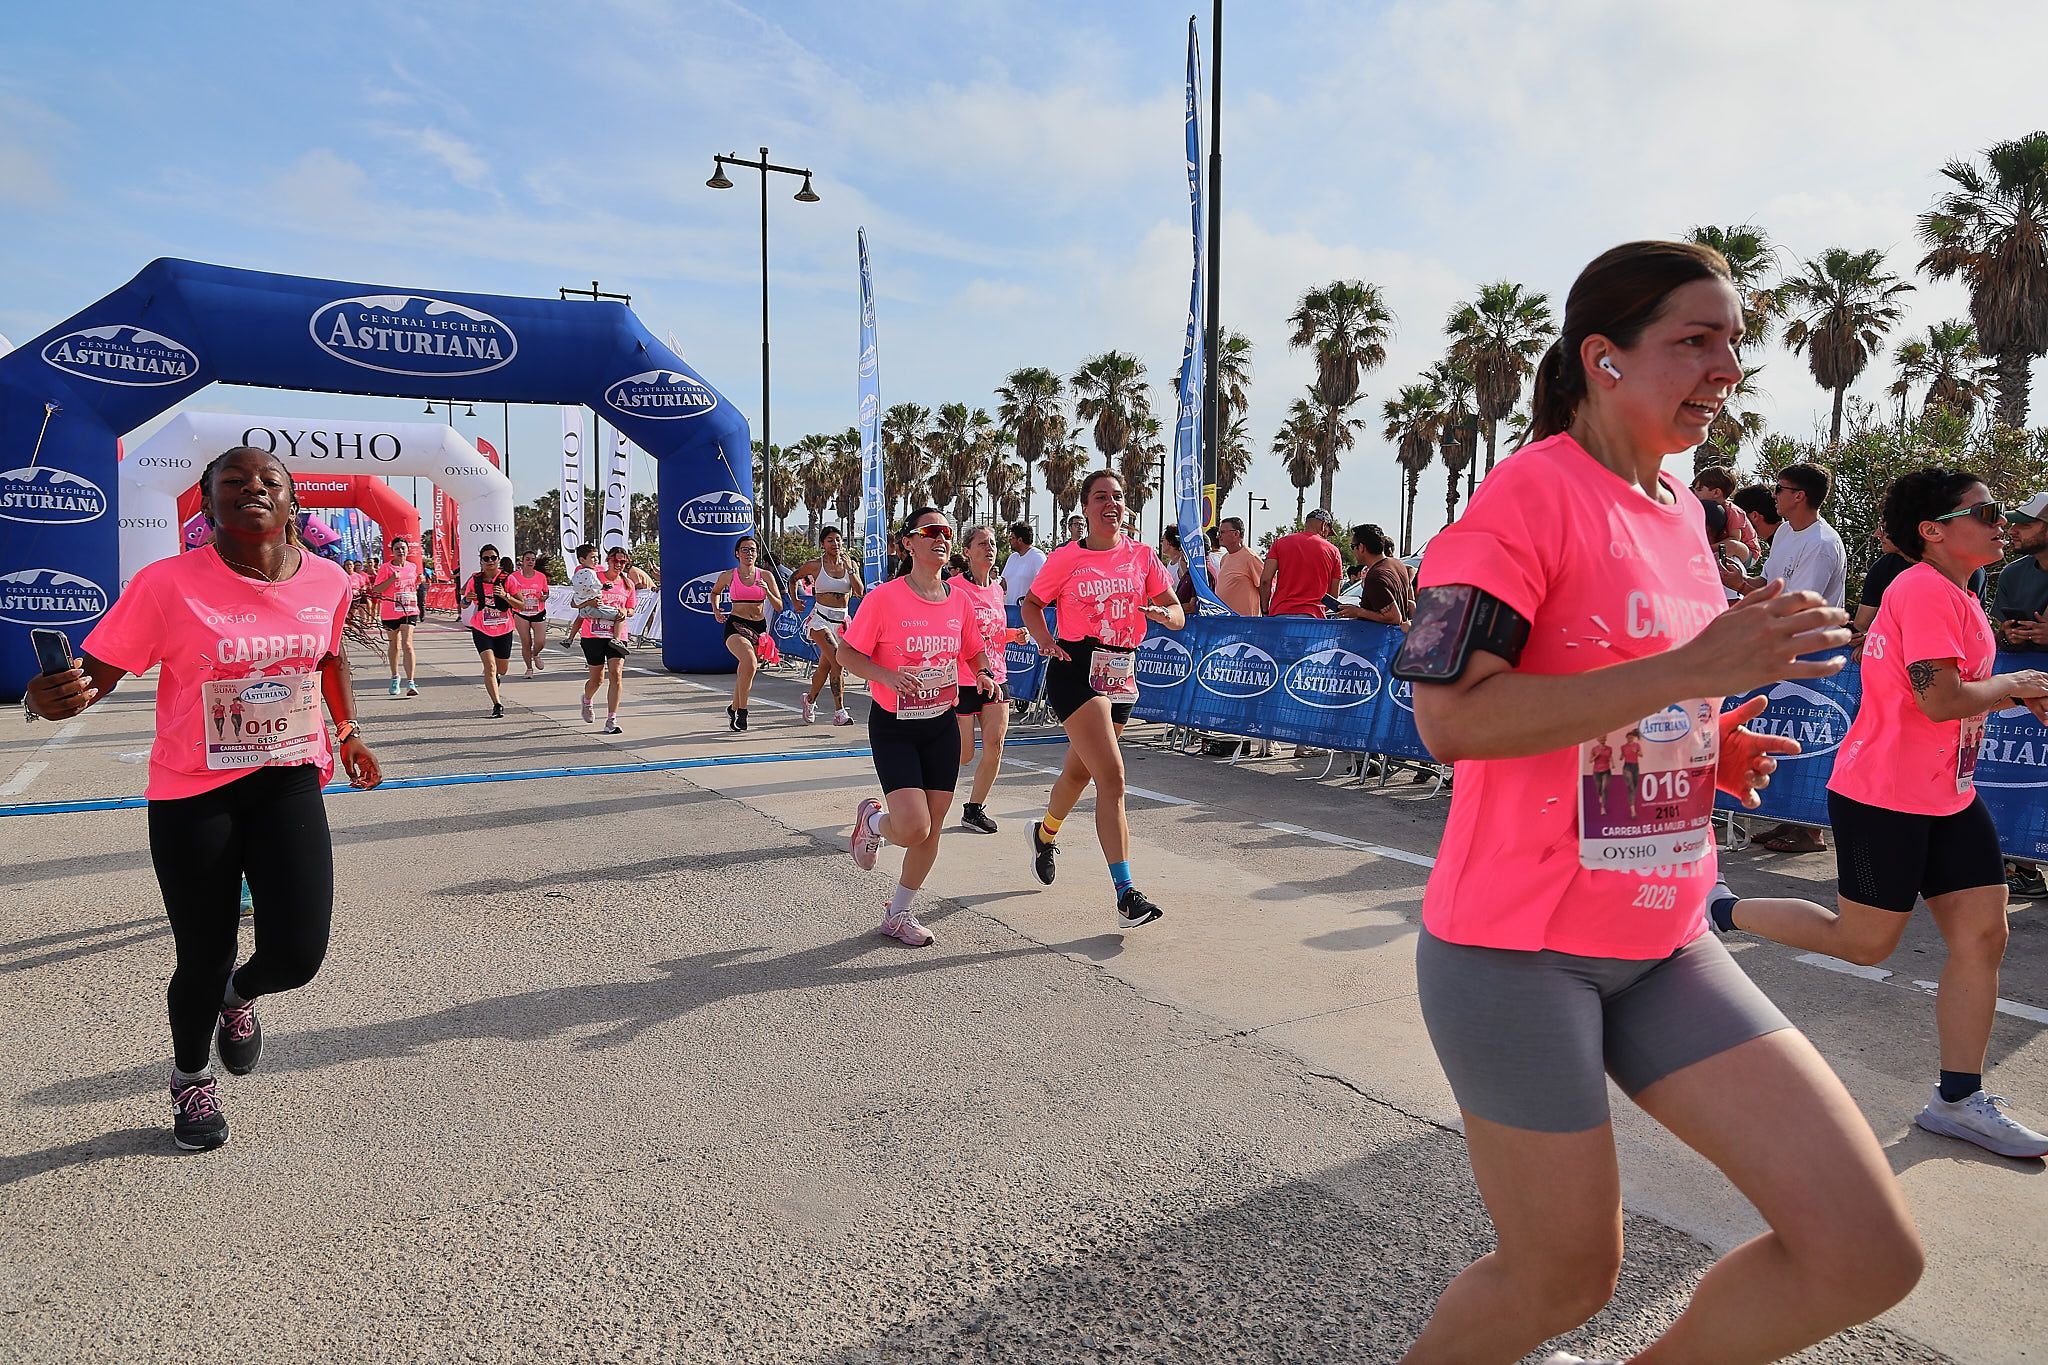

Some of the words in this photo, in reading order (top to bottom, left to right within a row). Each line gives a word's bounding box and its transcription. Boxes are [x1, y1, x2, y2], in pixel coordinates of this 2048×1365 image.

[360, 313, 426, 328] CENTRAL
[432, 320, 496, 334] LECHERA
[326, 312, 503, 360] ASTURIANA
[79, 341, 131, 352] CENTRAL
[136, 347, 186, 360] LECHERA
[51, 341, 187, 376] ASTURIANA
[614, 388, 712, 407] ASTURIANA
[241, 427, 402, 462] OYSHO
[138, 457, 192, 469] OYSHO
[444, 466, 488, 476] OYSHO
[4, 484, 49, 492] CENTRAL
[54, 487, 96, 497] LECHERA
[293, 480, 349, 491] antander
[118, 518, 168, 529] OYSHO
[469, 523, 509, 533] OYSHO
[55, 588, 97, 596] LECHERA
[1078, 577, 1135, 598] CARRERA
[1111, 598, 1129, 620] DE
[207, 613, 257, 625] OYSHO
[901, 620, 929, 628] OYSHO
[906, 635, 960, 653] CARRERA
[1863, 632, 1887, 660] ES
[1136, 659, 1186, 677] STURIANA
[1201, 659, 1270, 687] ASTURIANA
[1340, 669, 1372, 678] LECHERA
[1289, 667, 1372, 695] ASTURIANA
[244, 691, 288, 701] ASTURIANA
[918, 687, 940, 699] 016
[1771, 706, 1833, 719] LECHERA
[245, 718, 288, 735] 016
[1643, 720, 1687, 734] ASTURIANA
[1751, 717, 1834, 744] RIANA
[2003, 725, 2048, 737] LECH
[257, 736, 278, 744] 6132
[222, 755, 259, 764] OYSHO
[1641, 770, 1690, 802] 016
[1655, 806, 1680, 819] 2101
[1602, 826, 1641, 837] CARRERA
[1642, 825, 1652, 834] DE
[1653, 823, 1664, 833] LA
[1603, 844, 1657, 859] OYSHO
[1632, 884, 1677, 910] 2026
